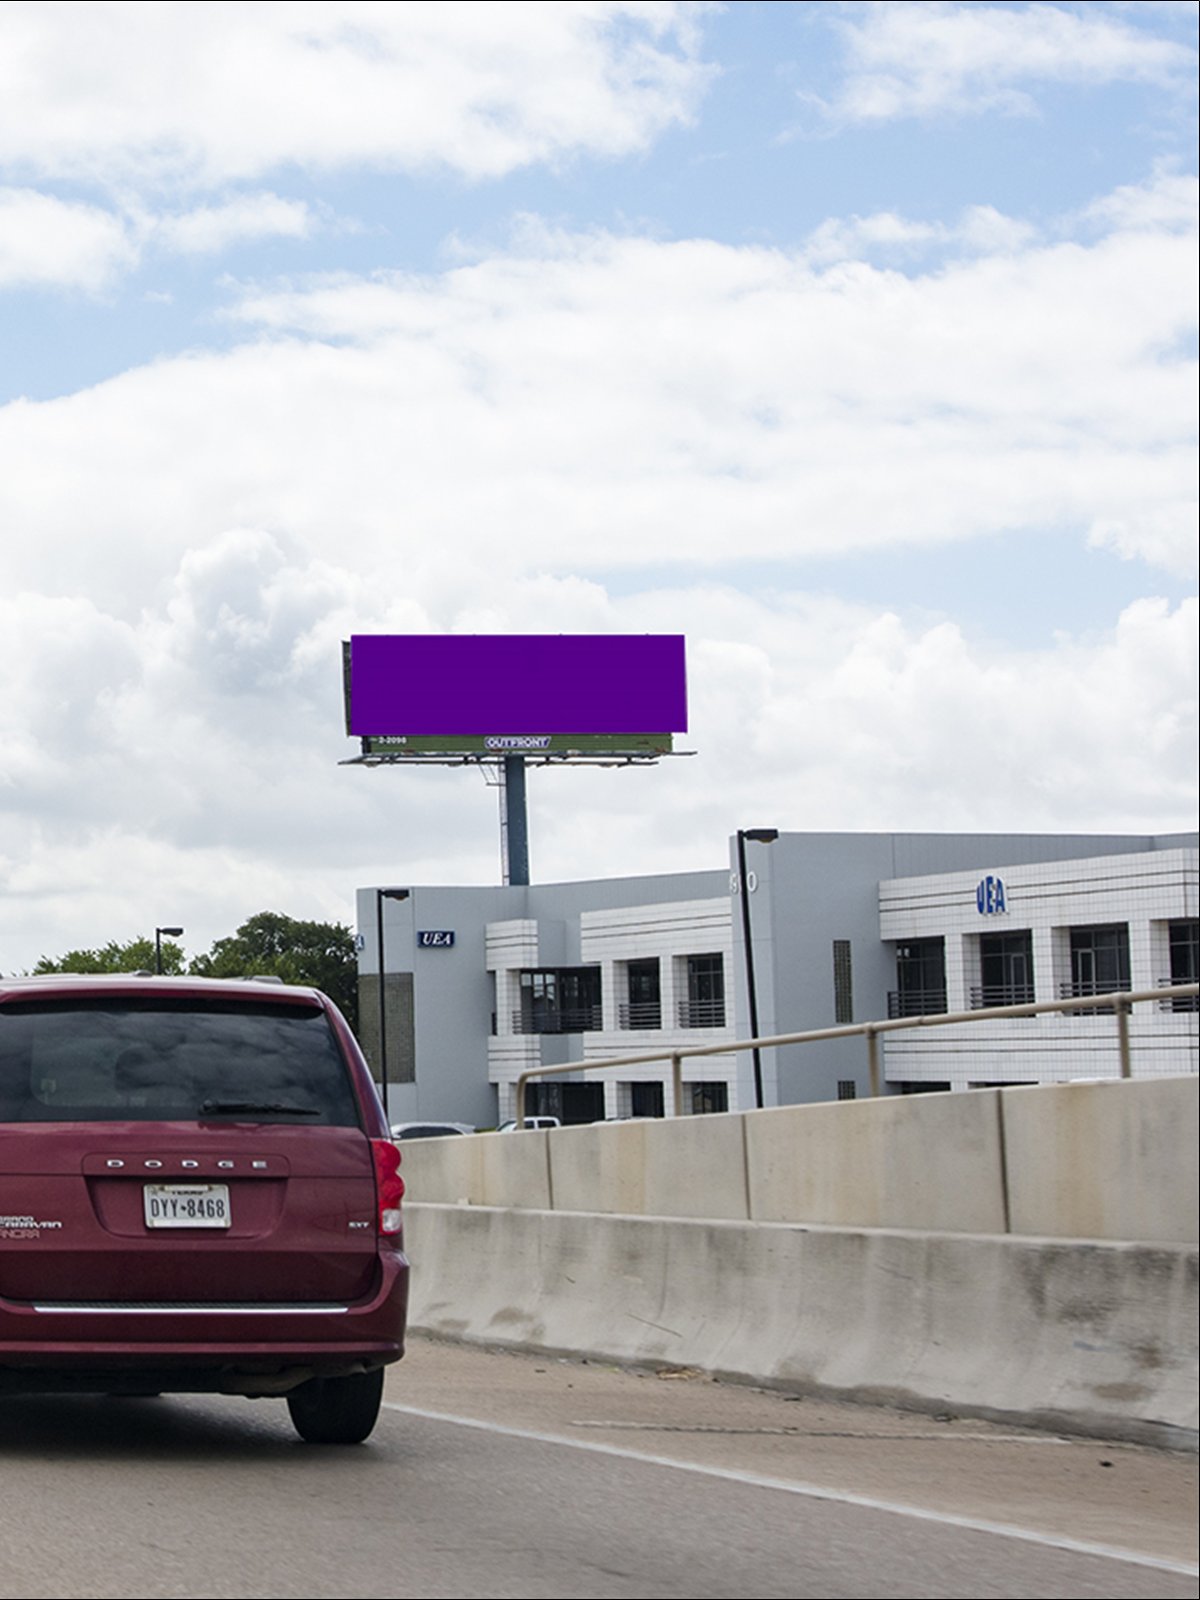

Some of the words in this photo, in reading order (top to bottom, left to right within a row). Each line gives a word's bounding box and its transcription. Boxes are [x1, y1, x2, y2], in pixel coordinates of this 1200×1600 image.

[485, 736, 550, 748] OUTFRONT
[977, 875, 1006, 914] UEA
[422, 932, 451, 945] UEA
[107, 1159, 267, 1169] DODGE
